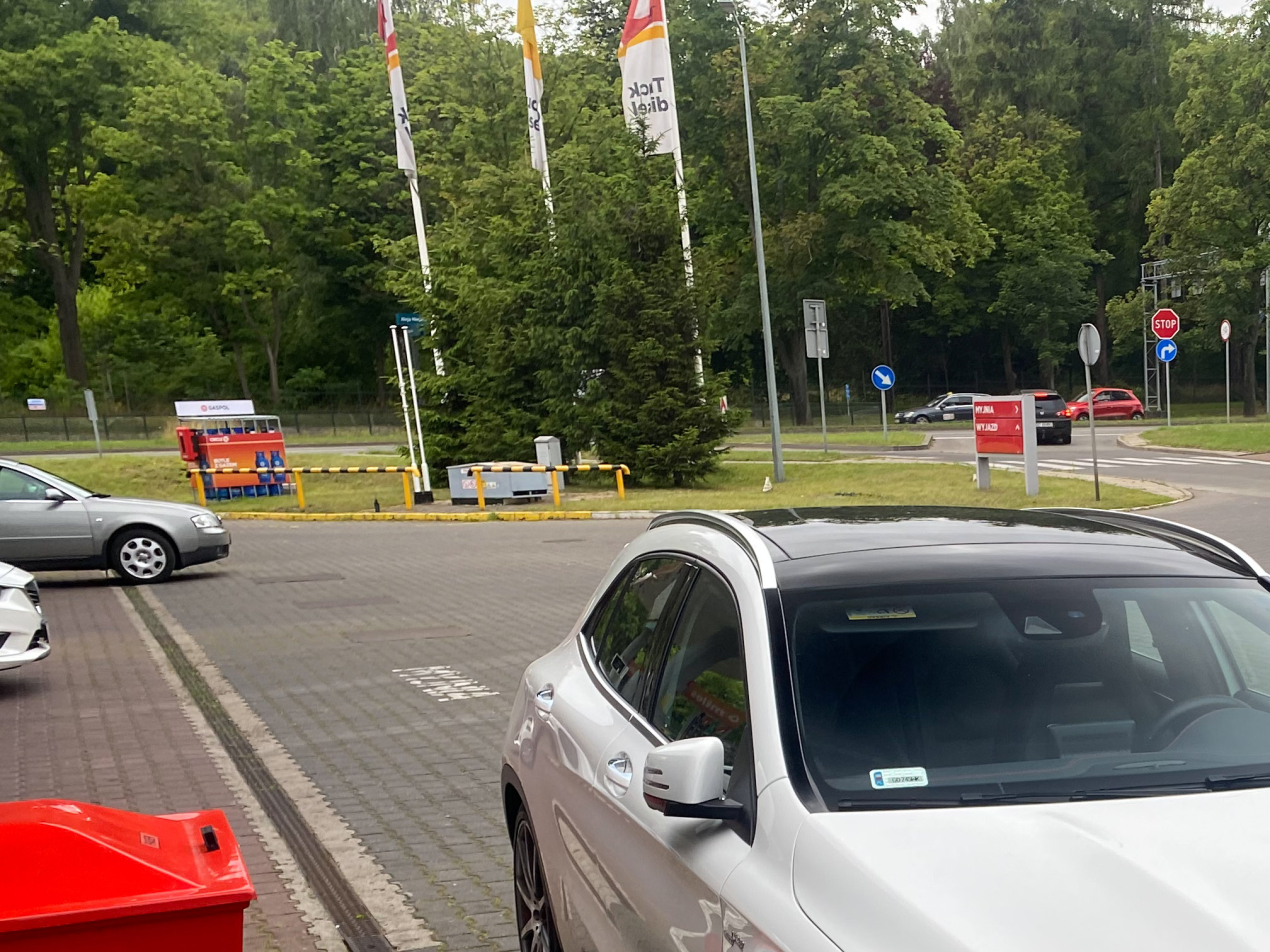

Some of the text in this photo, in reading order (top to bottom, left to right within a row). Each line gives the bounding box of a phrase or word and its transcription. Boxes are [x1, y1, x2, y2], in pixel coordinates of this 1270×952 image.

[1155, 319, 1177, 329] STOP
[975, 405, 994, 414] MYJNIA
[976, 423, 998, 431] WYJAZD
